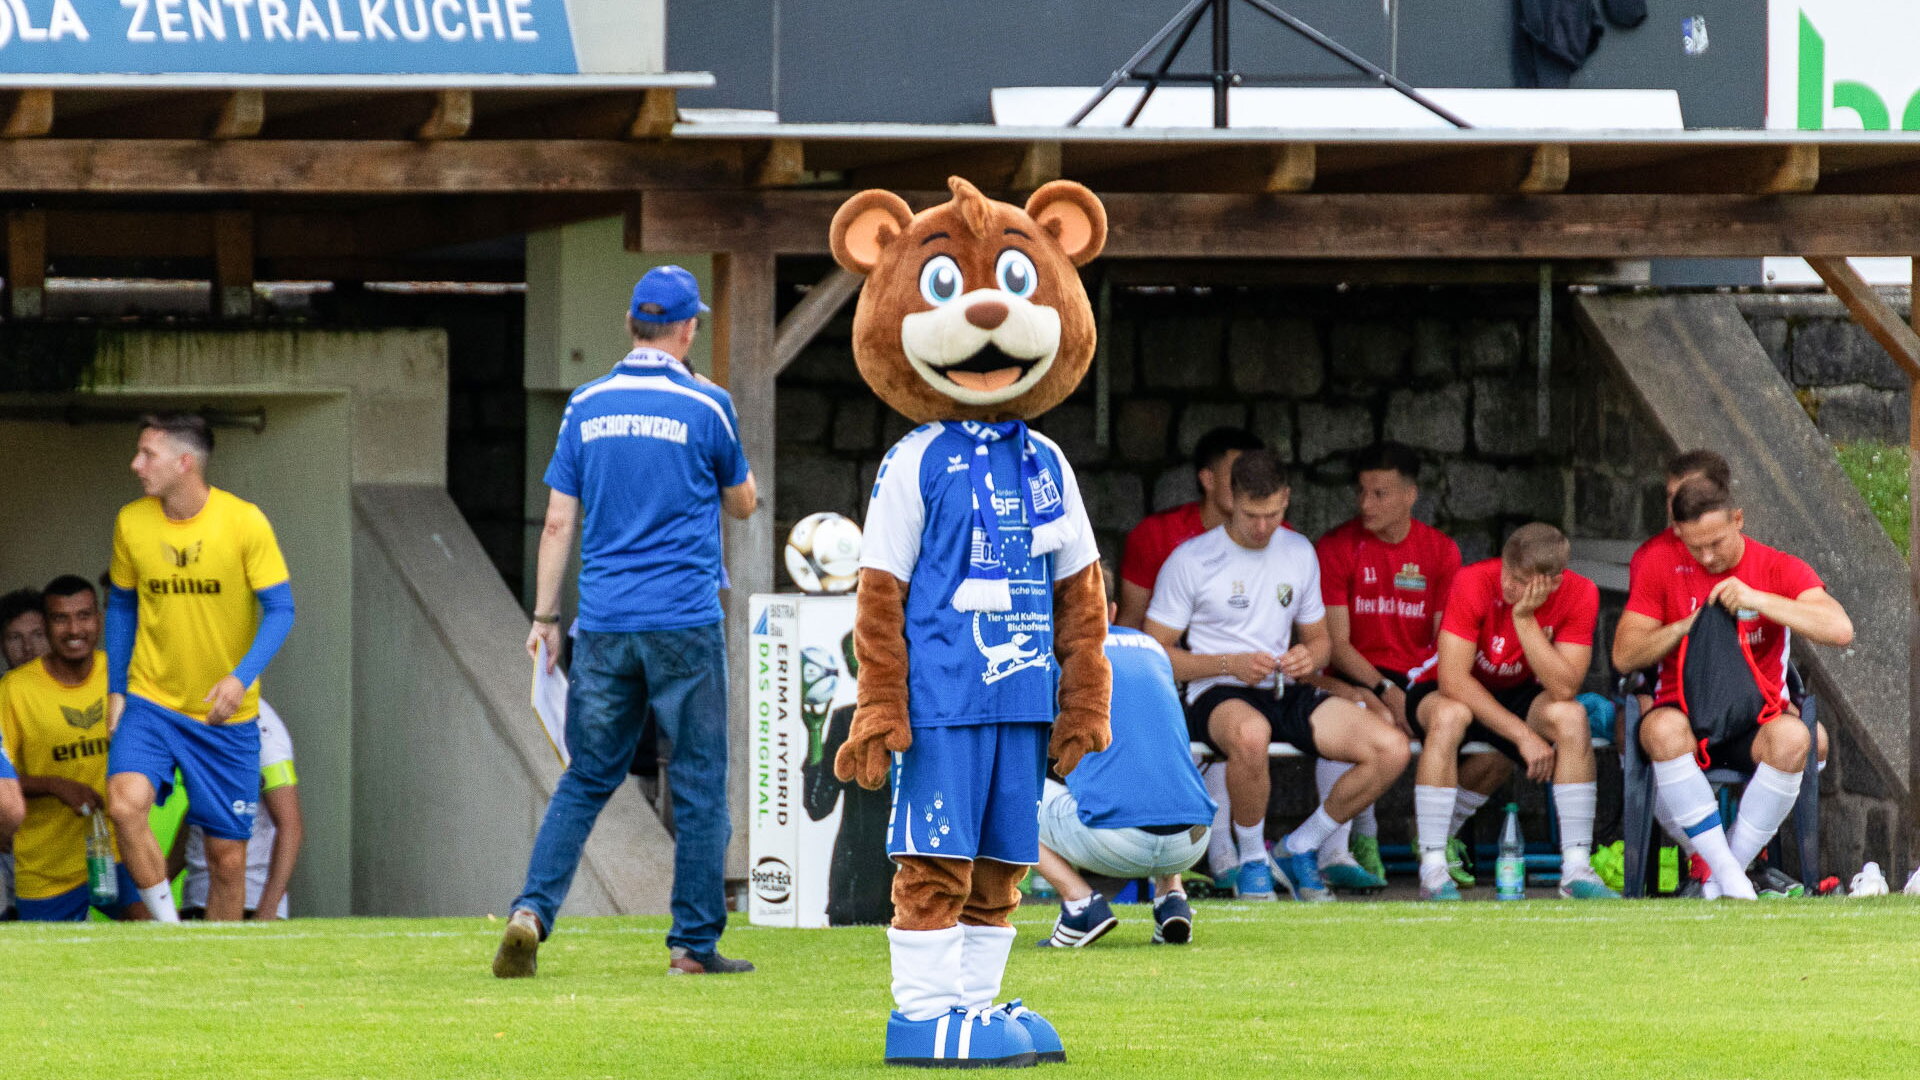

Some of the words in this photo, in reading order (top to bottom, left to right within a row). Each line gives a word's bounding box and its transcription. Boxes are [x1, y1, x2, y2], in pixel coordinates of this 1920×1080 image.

[580, 413, 688, 444] BISCHOFSWERDA
[148, 573, 221, 595] erima
[758, 642, 770, 691] DAS
[777, 643, 789, 721] ERIMA
[52, 735, 110, 762] erim
[777, 732, 788, 825] HYBRID
